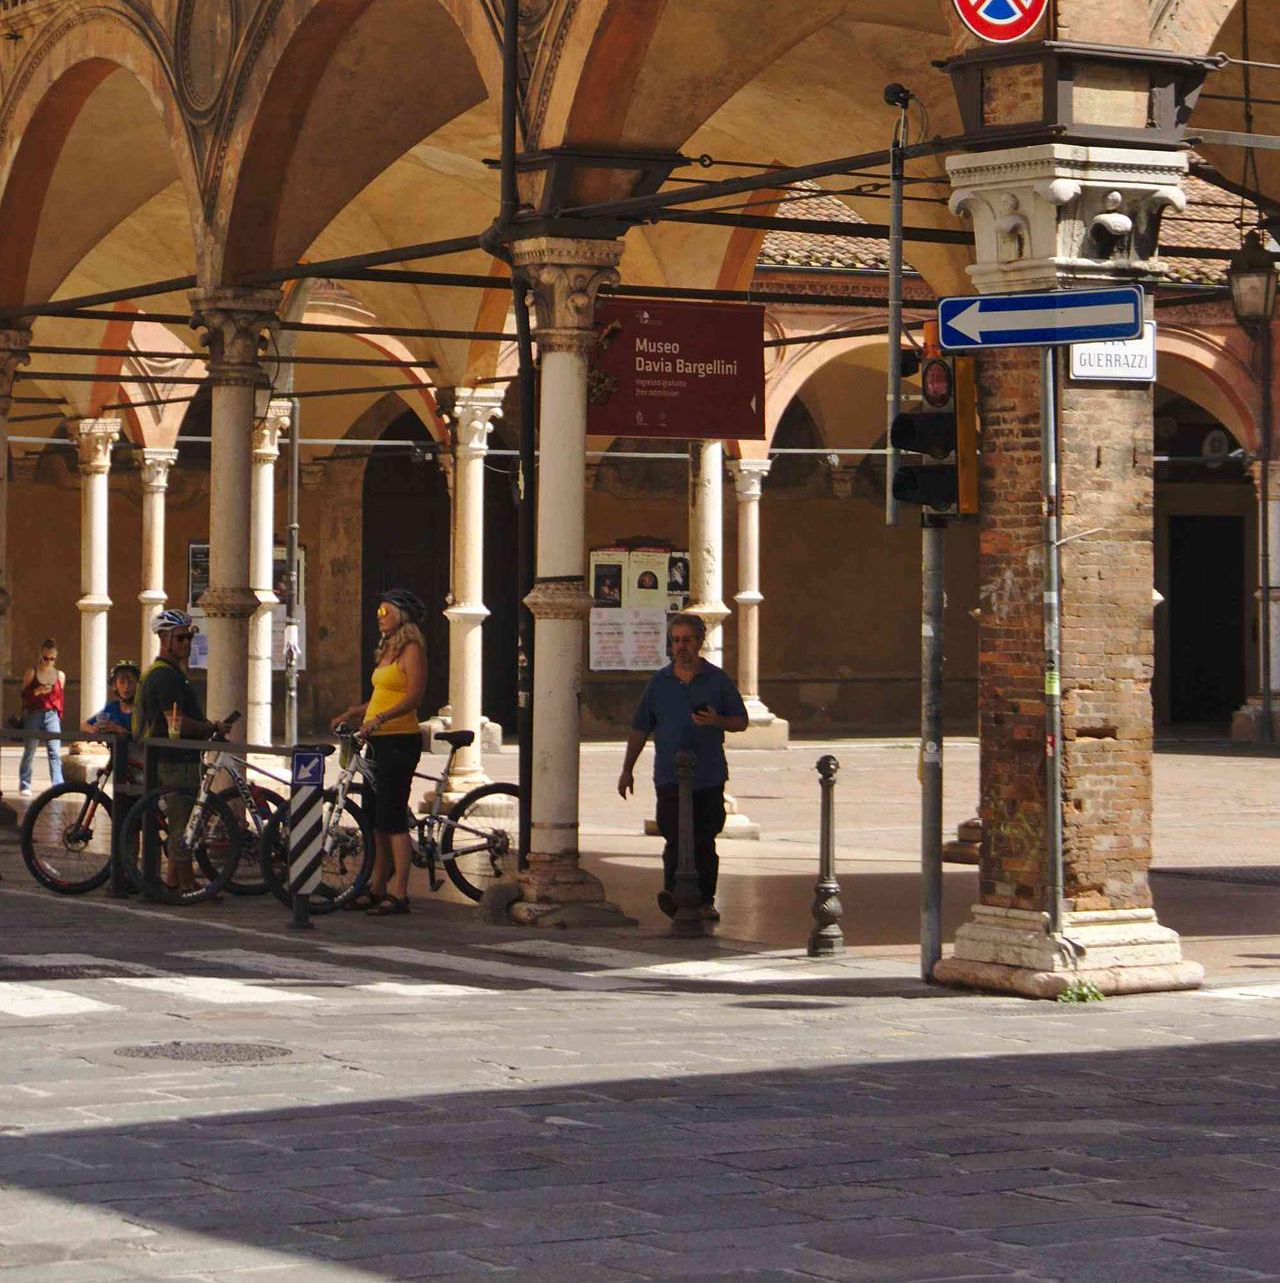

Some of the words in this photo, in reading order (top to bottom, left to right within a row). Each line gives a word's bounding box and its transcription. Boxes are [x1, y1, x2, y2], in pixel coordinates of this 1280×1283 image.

[635, 338, 680, 354] Museo
[635, 357, 672, 373] Davia
[676, 359, 737, 377] Bargellini
[1079, 352, 1148, 368] GUERRAZZI
